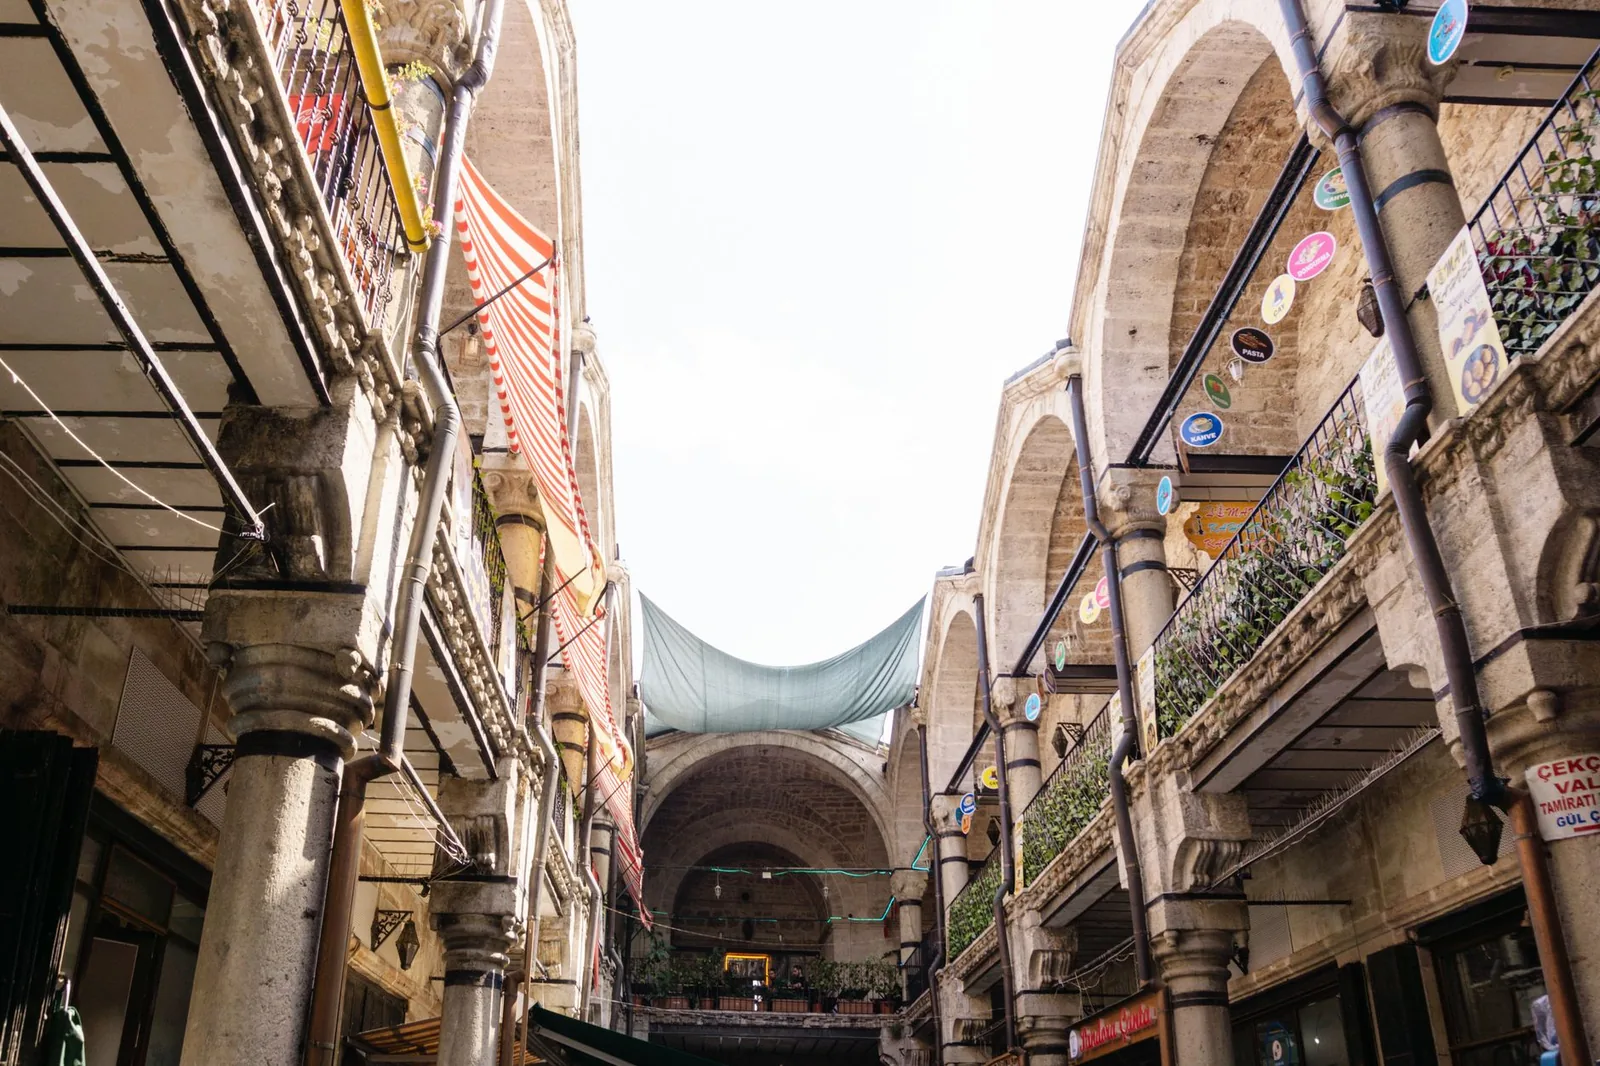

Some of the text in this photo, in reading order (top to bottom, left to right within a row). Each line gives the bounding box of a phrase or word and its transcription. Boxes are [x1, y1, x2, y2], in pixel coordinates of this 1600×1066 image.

[1296, 251, 1331, 278] DONDURMA
[1242, 348, 1265, 359] PASTA
[1539, 793, 1597, 815] TAMİRATI
[1556, 812, 1586, 828] GÜL
